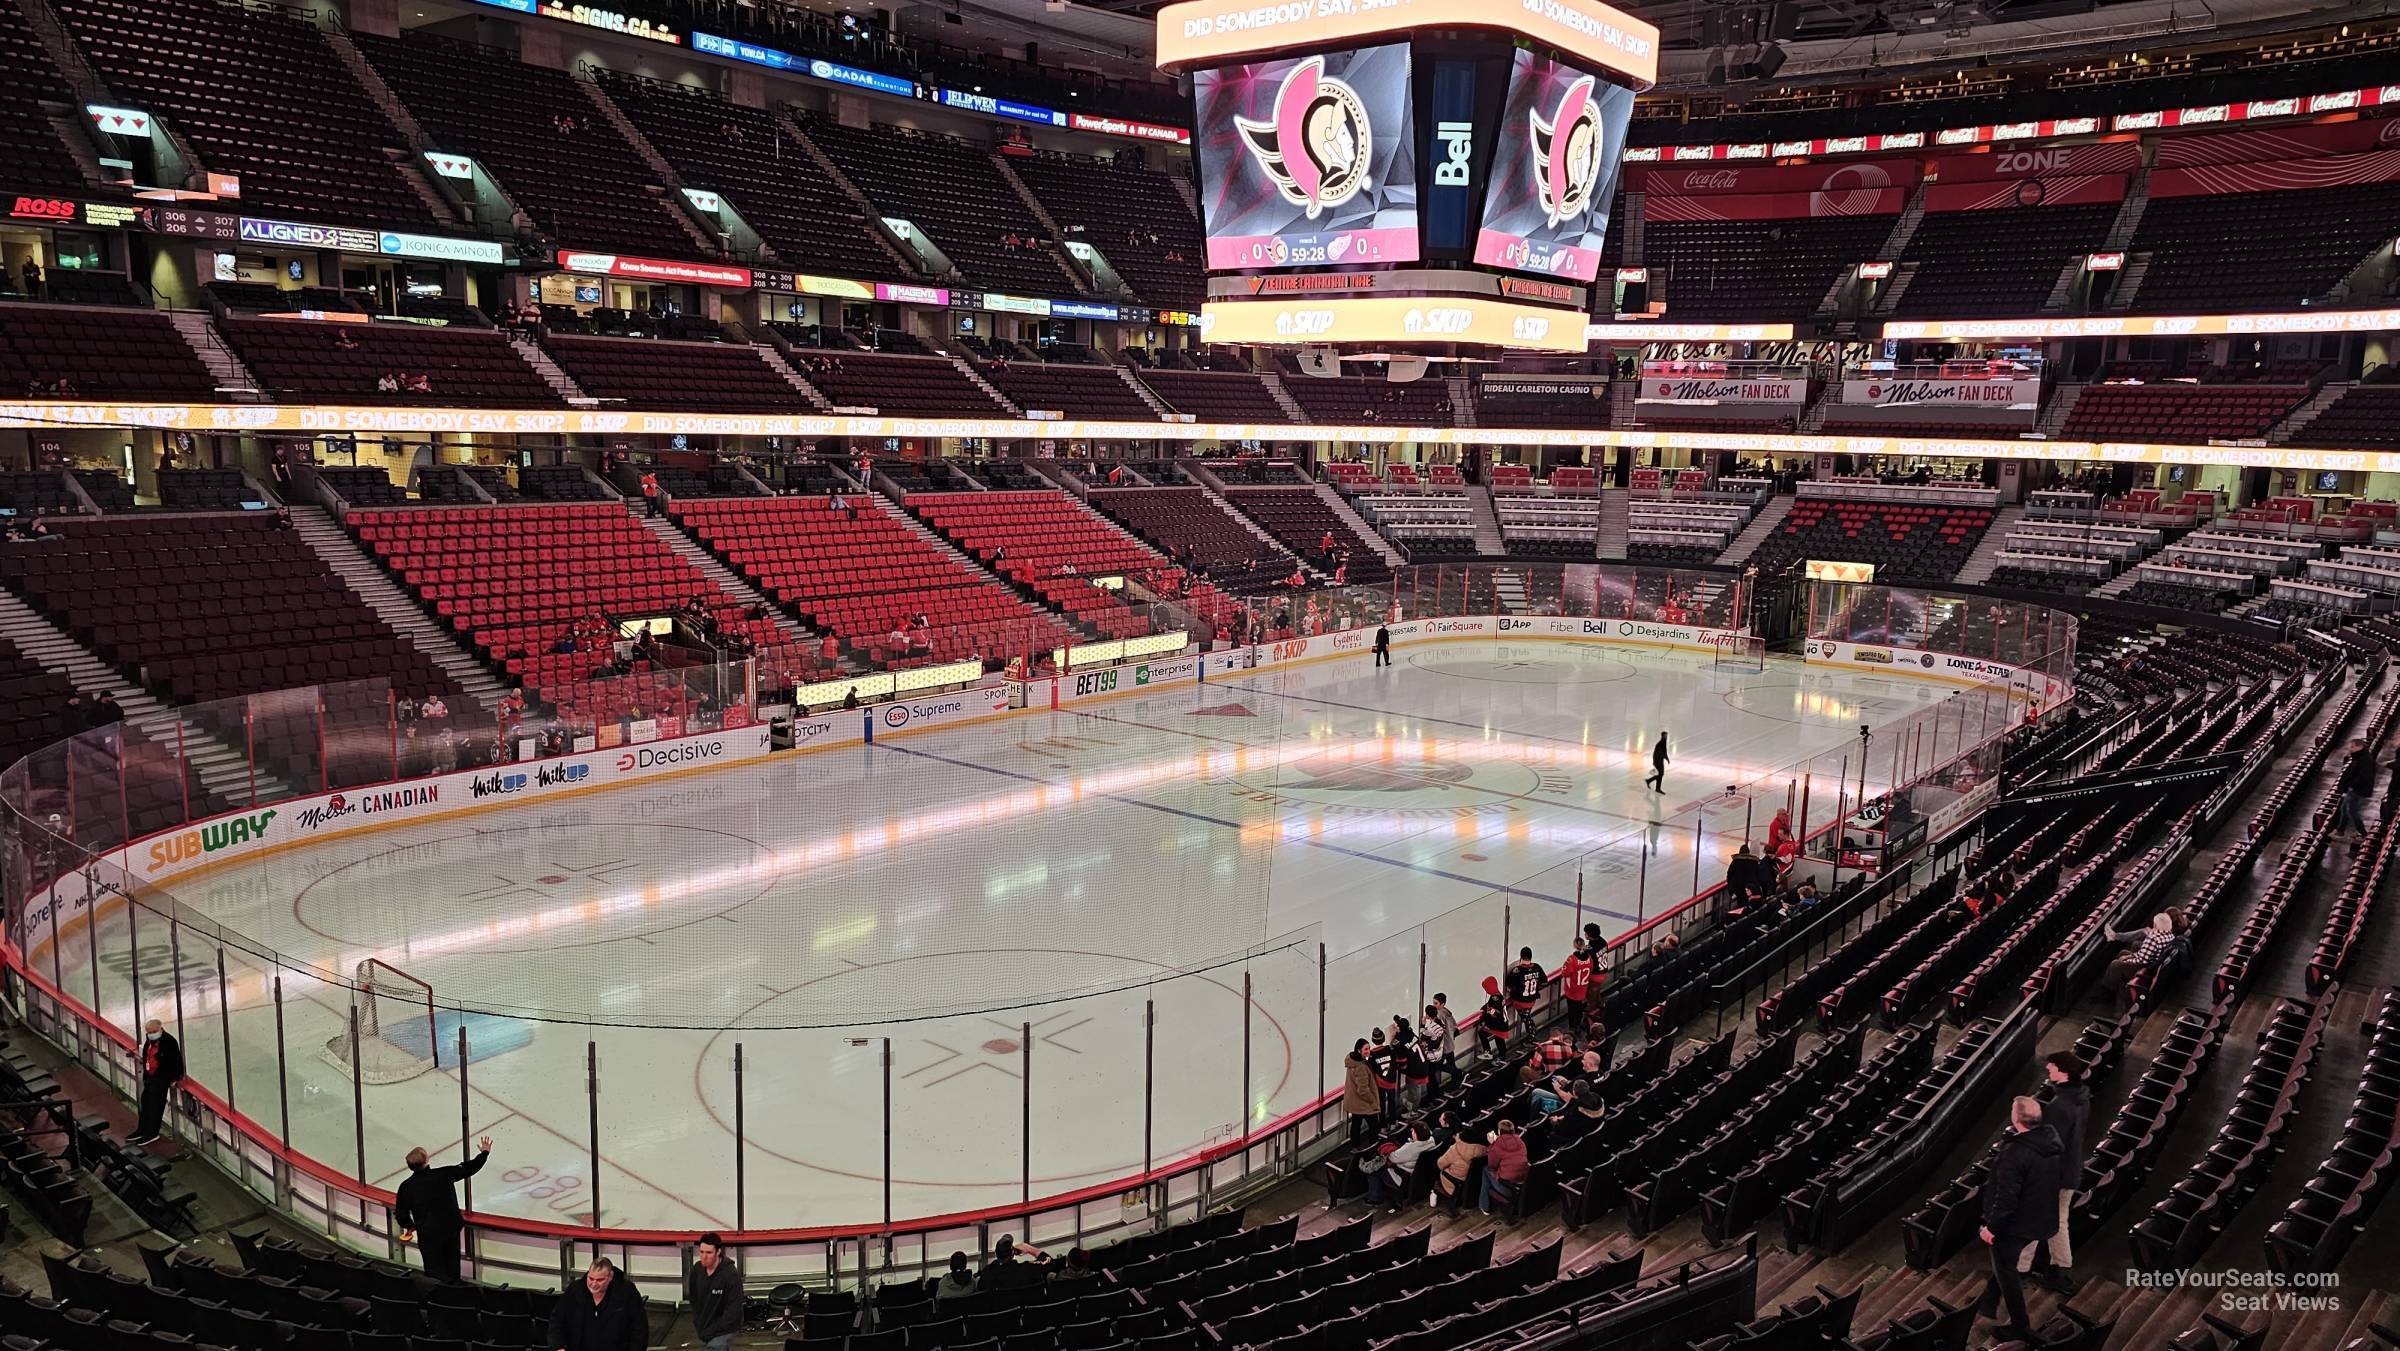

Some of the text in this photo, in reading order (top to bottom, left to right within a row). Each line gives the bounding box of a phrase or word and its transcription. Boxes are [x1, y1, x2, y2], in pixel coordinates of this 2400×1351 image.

[572, 5, 651, 39] SIGNS.CA
[1184, 17, 1213, 38] DID
[1216, 3, 1313, 33] SOMEBODY
[1545, 1, 1600, 39] SOMEBODY
[1604, 26, 1624, 52] SAY,
[1626, 35, 1649, 58] SKIP?
[834, 70, 872, 85] GADAR
[2251, 99, 2295, 116] Coca-Cola
[2315, 92, 2358, 110] Coca-Cola
[2120, 112, 2160, 129] Coca-Cola
[2183, 105, 2226, 123] Coca-Cola
[1076, 116, 1178, 140] PowerSports & RV CANADA
[1997, 123, 2034, 139] Coca-Cola
[2057, 118, 2096, 133] Coca-Cola
[1884, 135, 1920, 150] Coca-Cola
[1940, 128, 1975, 144] Coca-Cola
[1775, 142, 1809, 156] Coca-Cola
[1829, 138, 1863, 153] Coca-Cola
[1435, 122, 1472, 186] Bell
[1996, 150, 2072, 172] ZONE
[1684, 169, 1740, 189] Coca-Cola
[14, 197, 76, 216] ROSS
[86, 204, 133, 214] PRODUCTION
[86, 212, 136, 222] TECHNOLOGY
[165, 212, 186, 222] 306
[214, 217, 234, 226] 307
[166, 224, 186, 233] 206
[216, 228, 235, 238] 207
[243, 223, 324, 243] ALIGNED
[406, 240, 501, 258] KONICA MINOLTA
[1252, 244, 1262, 260] 0
[1357, 238, 1367, 254] 0
[1507, 244, 1514, 260] 0
[1292, 247, 1325, 262] 59:28
[1529, 253, 1549, 269] 59:28
[1566, 254, 1573, 269] 0
[2090, 255, 2121, 269] Coca-Cola
[620, 262, 639, 272] Know
[754, 280, 766, 288] 208
[780, 274, 792, 282] 309
[898, 288, 936, 299] MAGENTA
[1170, 311, 1188, 325] RS
[1293, 310, 1334, 334] SKIP
[1423, 308, 1472, 334] SKIP
[2227, 316, 2346, 331] DID SOMEBODY
[1521, 318, 1549, 341] SKIP
[1897, 323, 1925, 336] SKIP
[1942, 322, 2124, 336] DID SOMEBODY SKIP?
[2164, 320, 2198, 333] SKIP
[1516, 385, 1557, 393] CARLETON
[1559, 386, 1589, 394] CASINO
[1673, 382, 1789, 399] Molson FAN DECK
[1882, 382, 2013, 403] Molson FAN DECK
[301, 410, 339, 429] DID
[345, 412, 464, 430] SOMEBODY
[515, 414, 564, 430] SKIP?
[643, 417, 671, 432] DID
[676, 418, 760, 433] SOMEBODY
[800, 420, 834, 433] SKIP?
[918, 422, 983, 435] SOMEBODY
[1669, 436, 1694, 447] DID
[1696, 436, 1766, 448] SOMEBODY
[1900, 442, 2091, 458] DID SOMEBODY SKIP?
[2162, 450, 2365, 468] DID SOMEBODY SKIP?
[1438, 622, 1483, 632] FairSquare
[1551, 621, 1606, 634] Fibe Bell
[1637, 626, 1690, 640] Desjardins
[1334, 632, 1362, 648] Gabriel
[1284, 640, 1307, 659] SKIP
[1139, 662, 1192, 678] enterprise
[1947, 659, 1974, 670] LONE
[1076, 670, 1117, 696] BET99
[1962, 671, 1980, 679] TEXAS
[889, 701, 961, 721] Esso Supreme
[638, 741, 723, 768] Decisive
[296, 784, 438, 830] Molson CANADIAN
[146, 808, 278, 874] SUBWAY
[1577, 968, 1590, 986] 12
